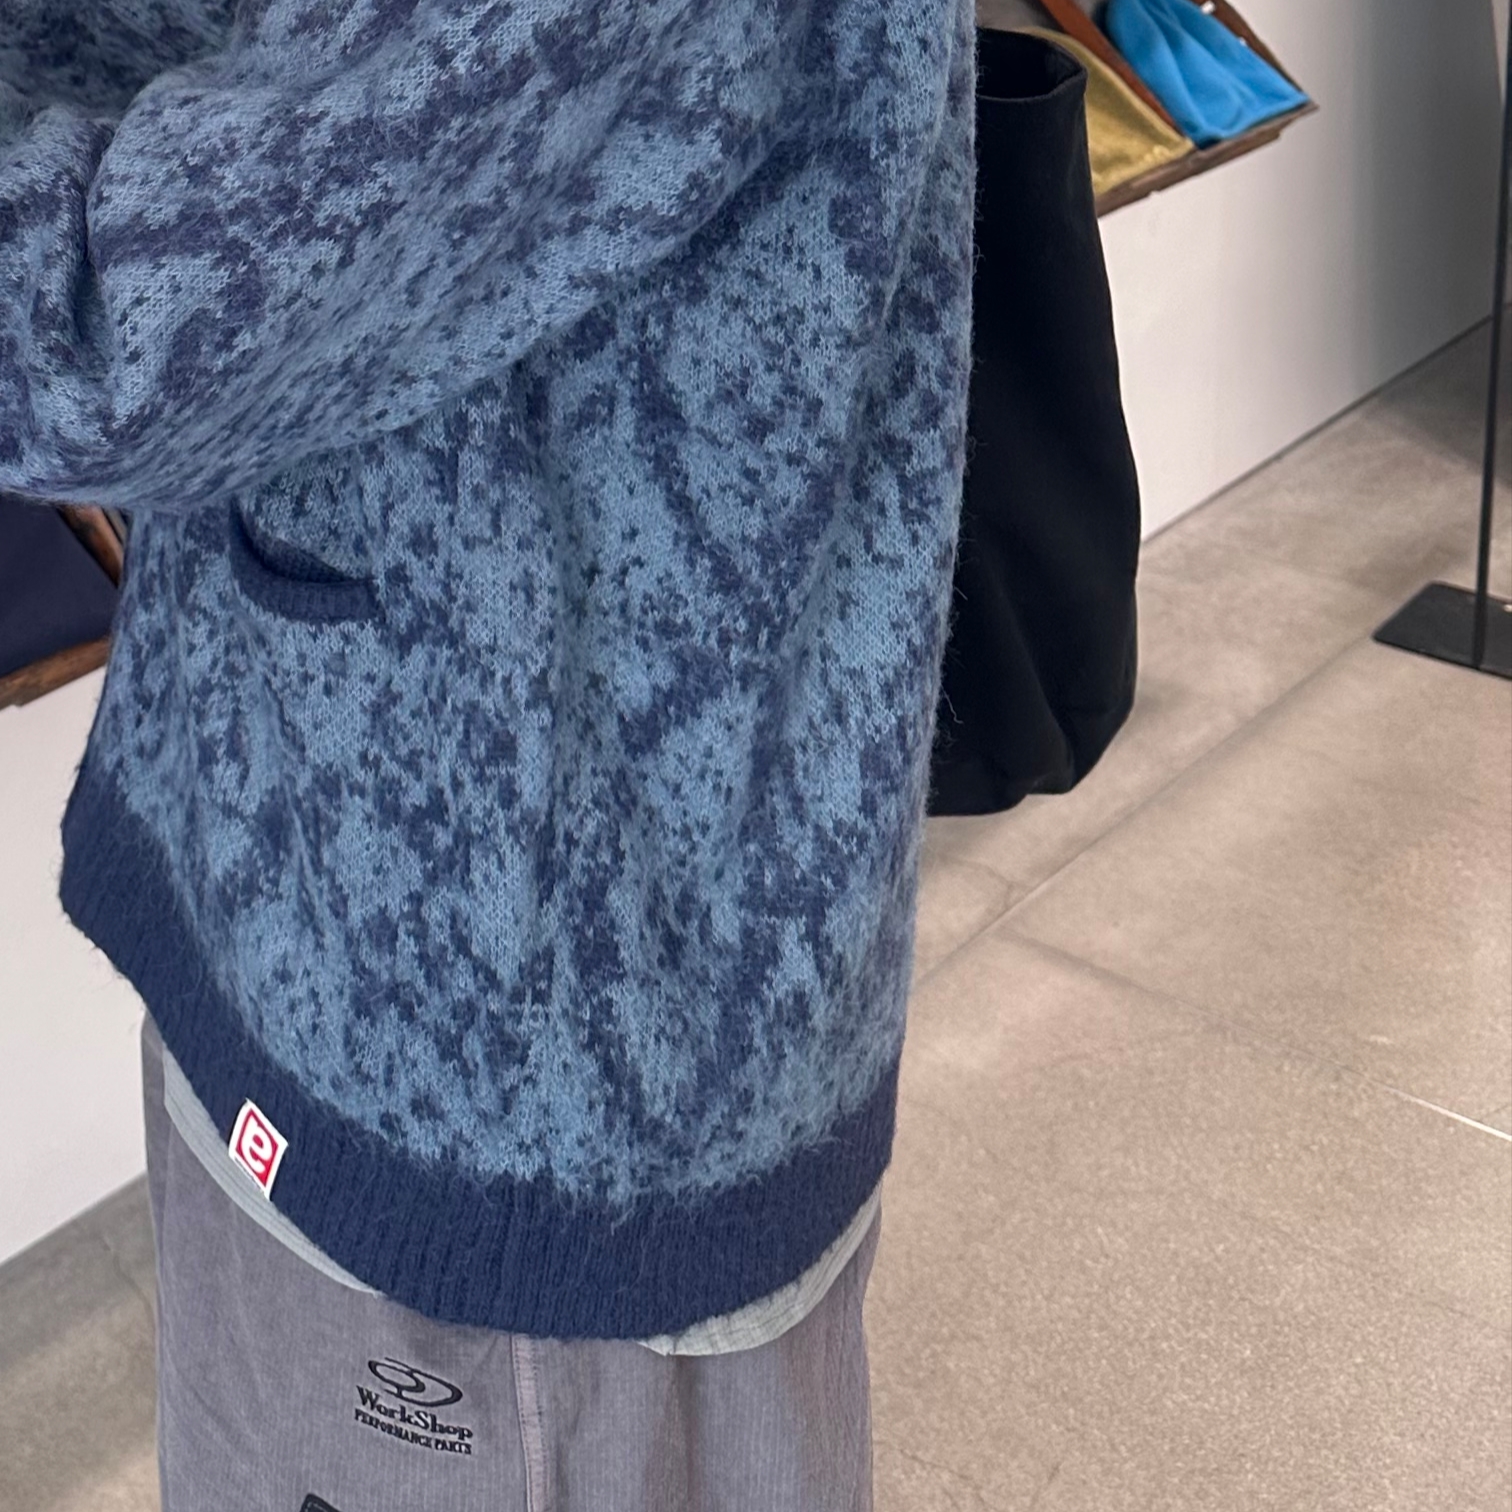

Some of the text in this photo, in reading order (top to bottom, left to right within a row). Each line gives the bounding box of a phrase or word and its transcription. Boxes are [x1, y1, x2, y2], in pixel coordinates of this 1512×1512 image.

[354, 1407, 472, 1455] PERFORMANCE PARTS
[356, 1385, 474, 1441] WorkShop
